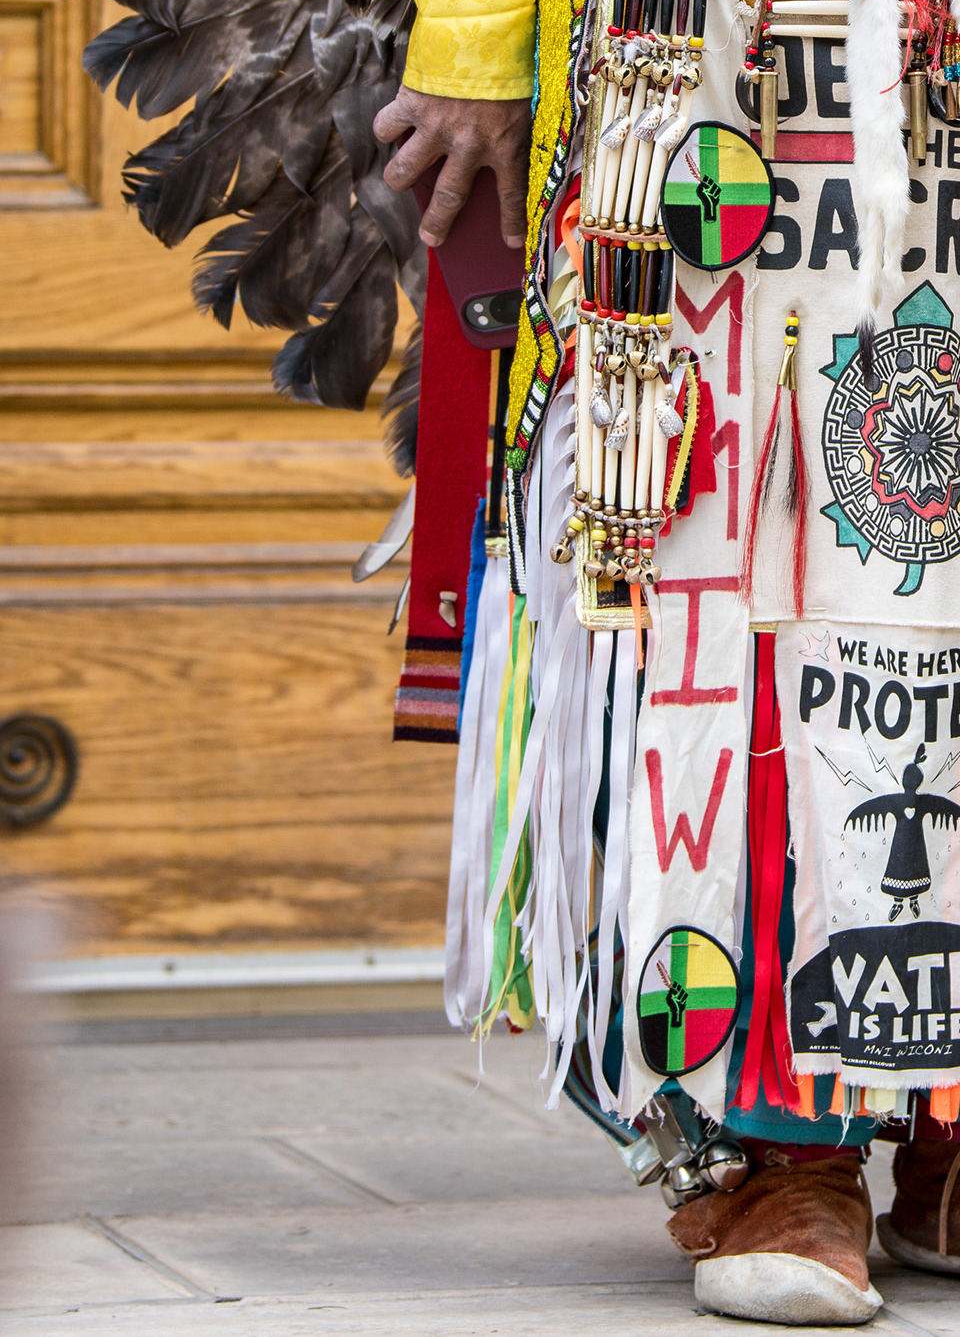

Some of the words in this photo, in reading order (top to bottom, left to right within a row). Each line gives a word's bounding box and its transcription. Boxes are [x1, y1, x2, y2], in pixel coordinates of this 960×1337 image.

[836, 636, 869, 667] WE
[873, 645, 909, 678] ARE
[848, 1010, 882, 1041] IS
[863, 1043, 893, 1058] MNI
[895, 1043, 954, 1058] WICONI
